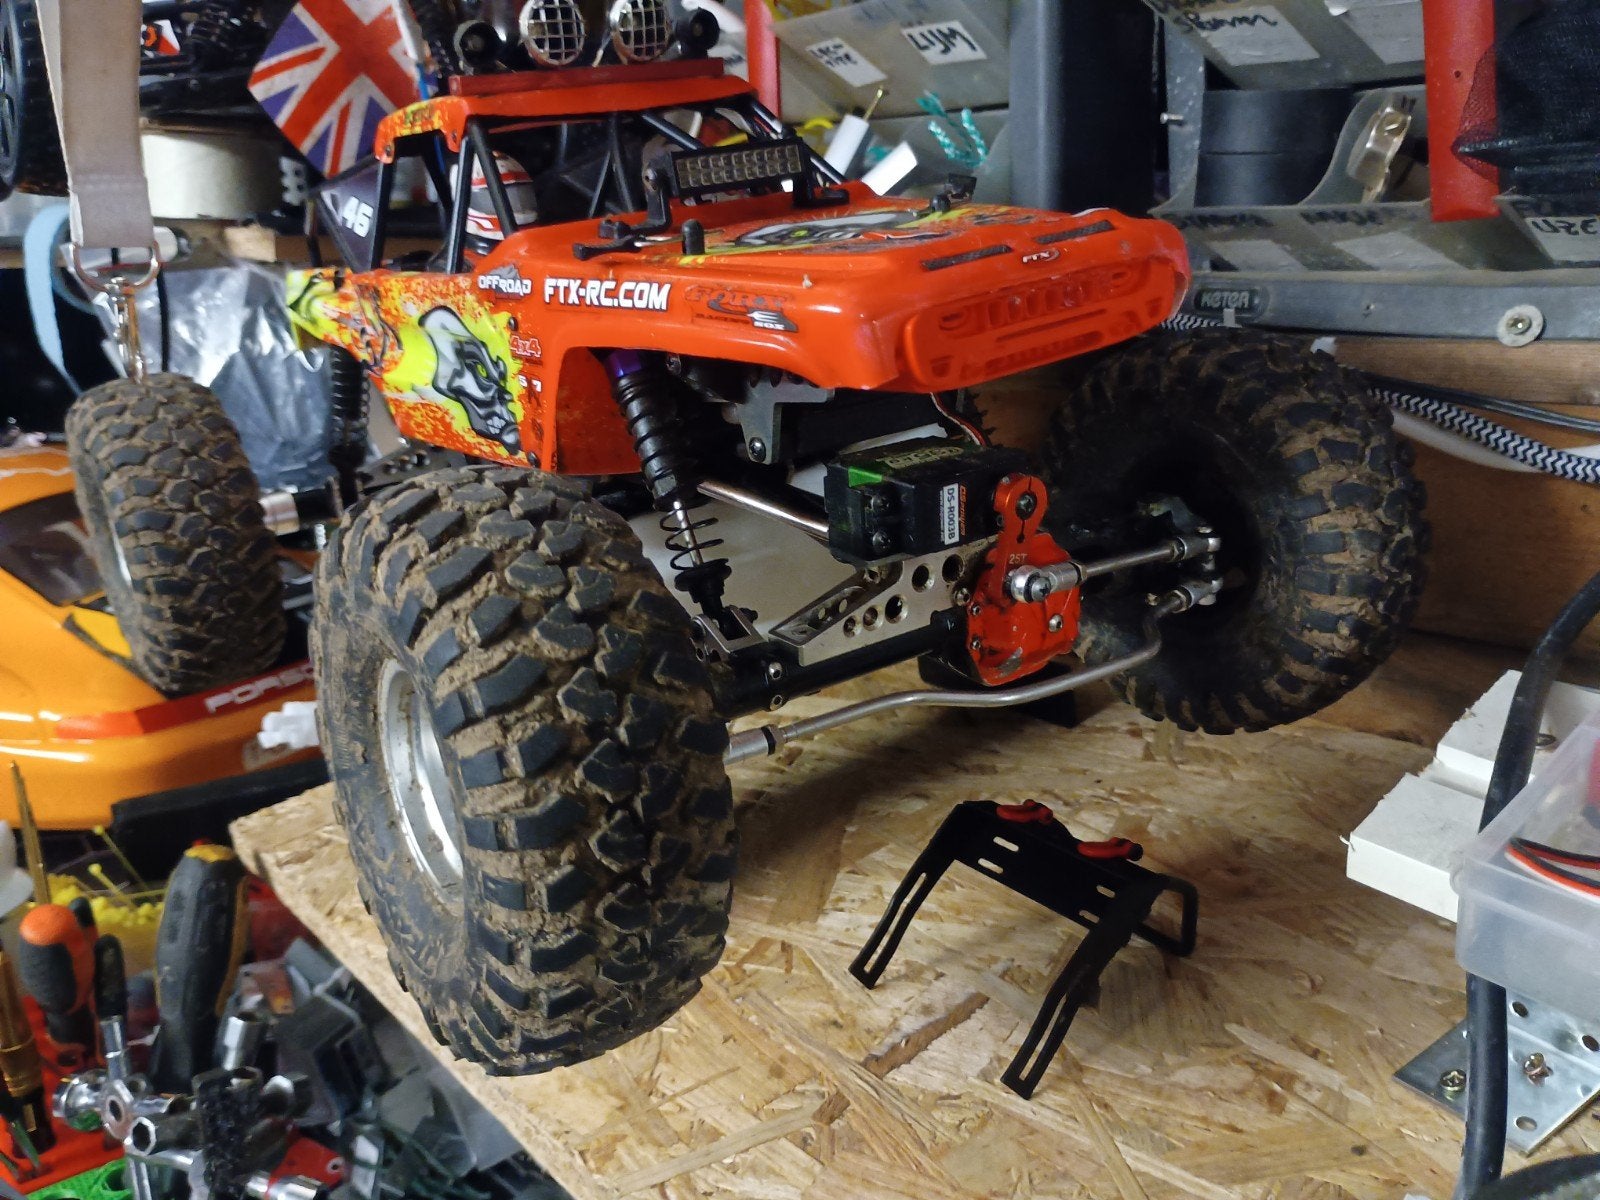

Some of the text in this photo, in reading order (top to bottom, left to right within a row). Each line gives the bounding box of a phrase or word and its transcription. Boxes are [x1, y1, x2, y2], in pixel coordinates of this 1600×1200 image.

[342, 195, 374, 238] 46
[477, 275, 532, 297] OFFROAD
[543, 277, 671, 311] FTX-RC.COM
[946, 487, 957, 541] DS-R003B
[1009, 553, 1029, 565] 25T
